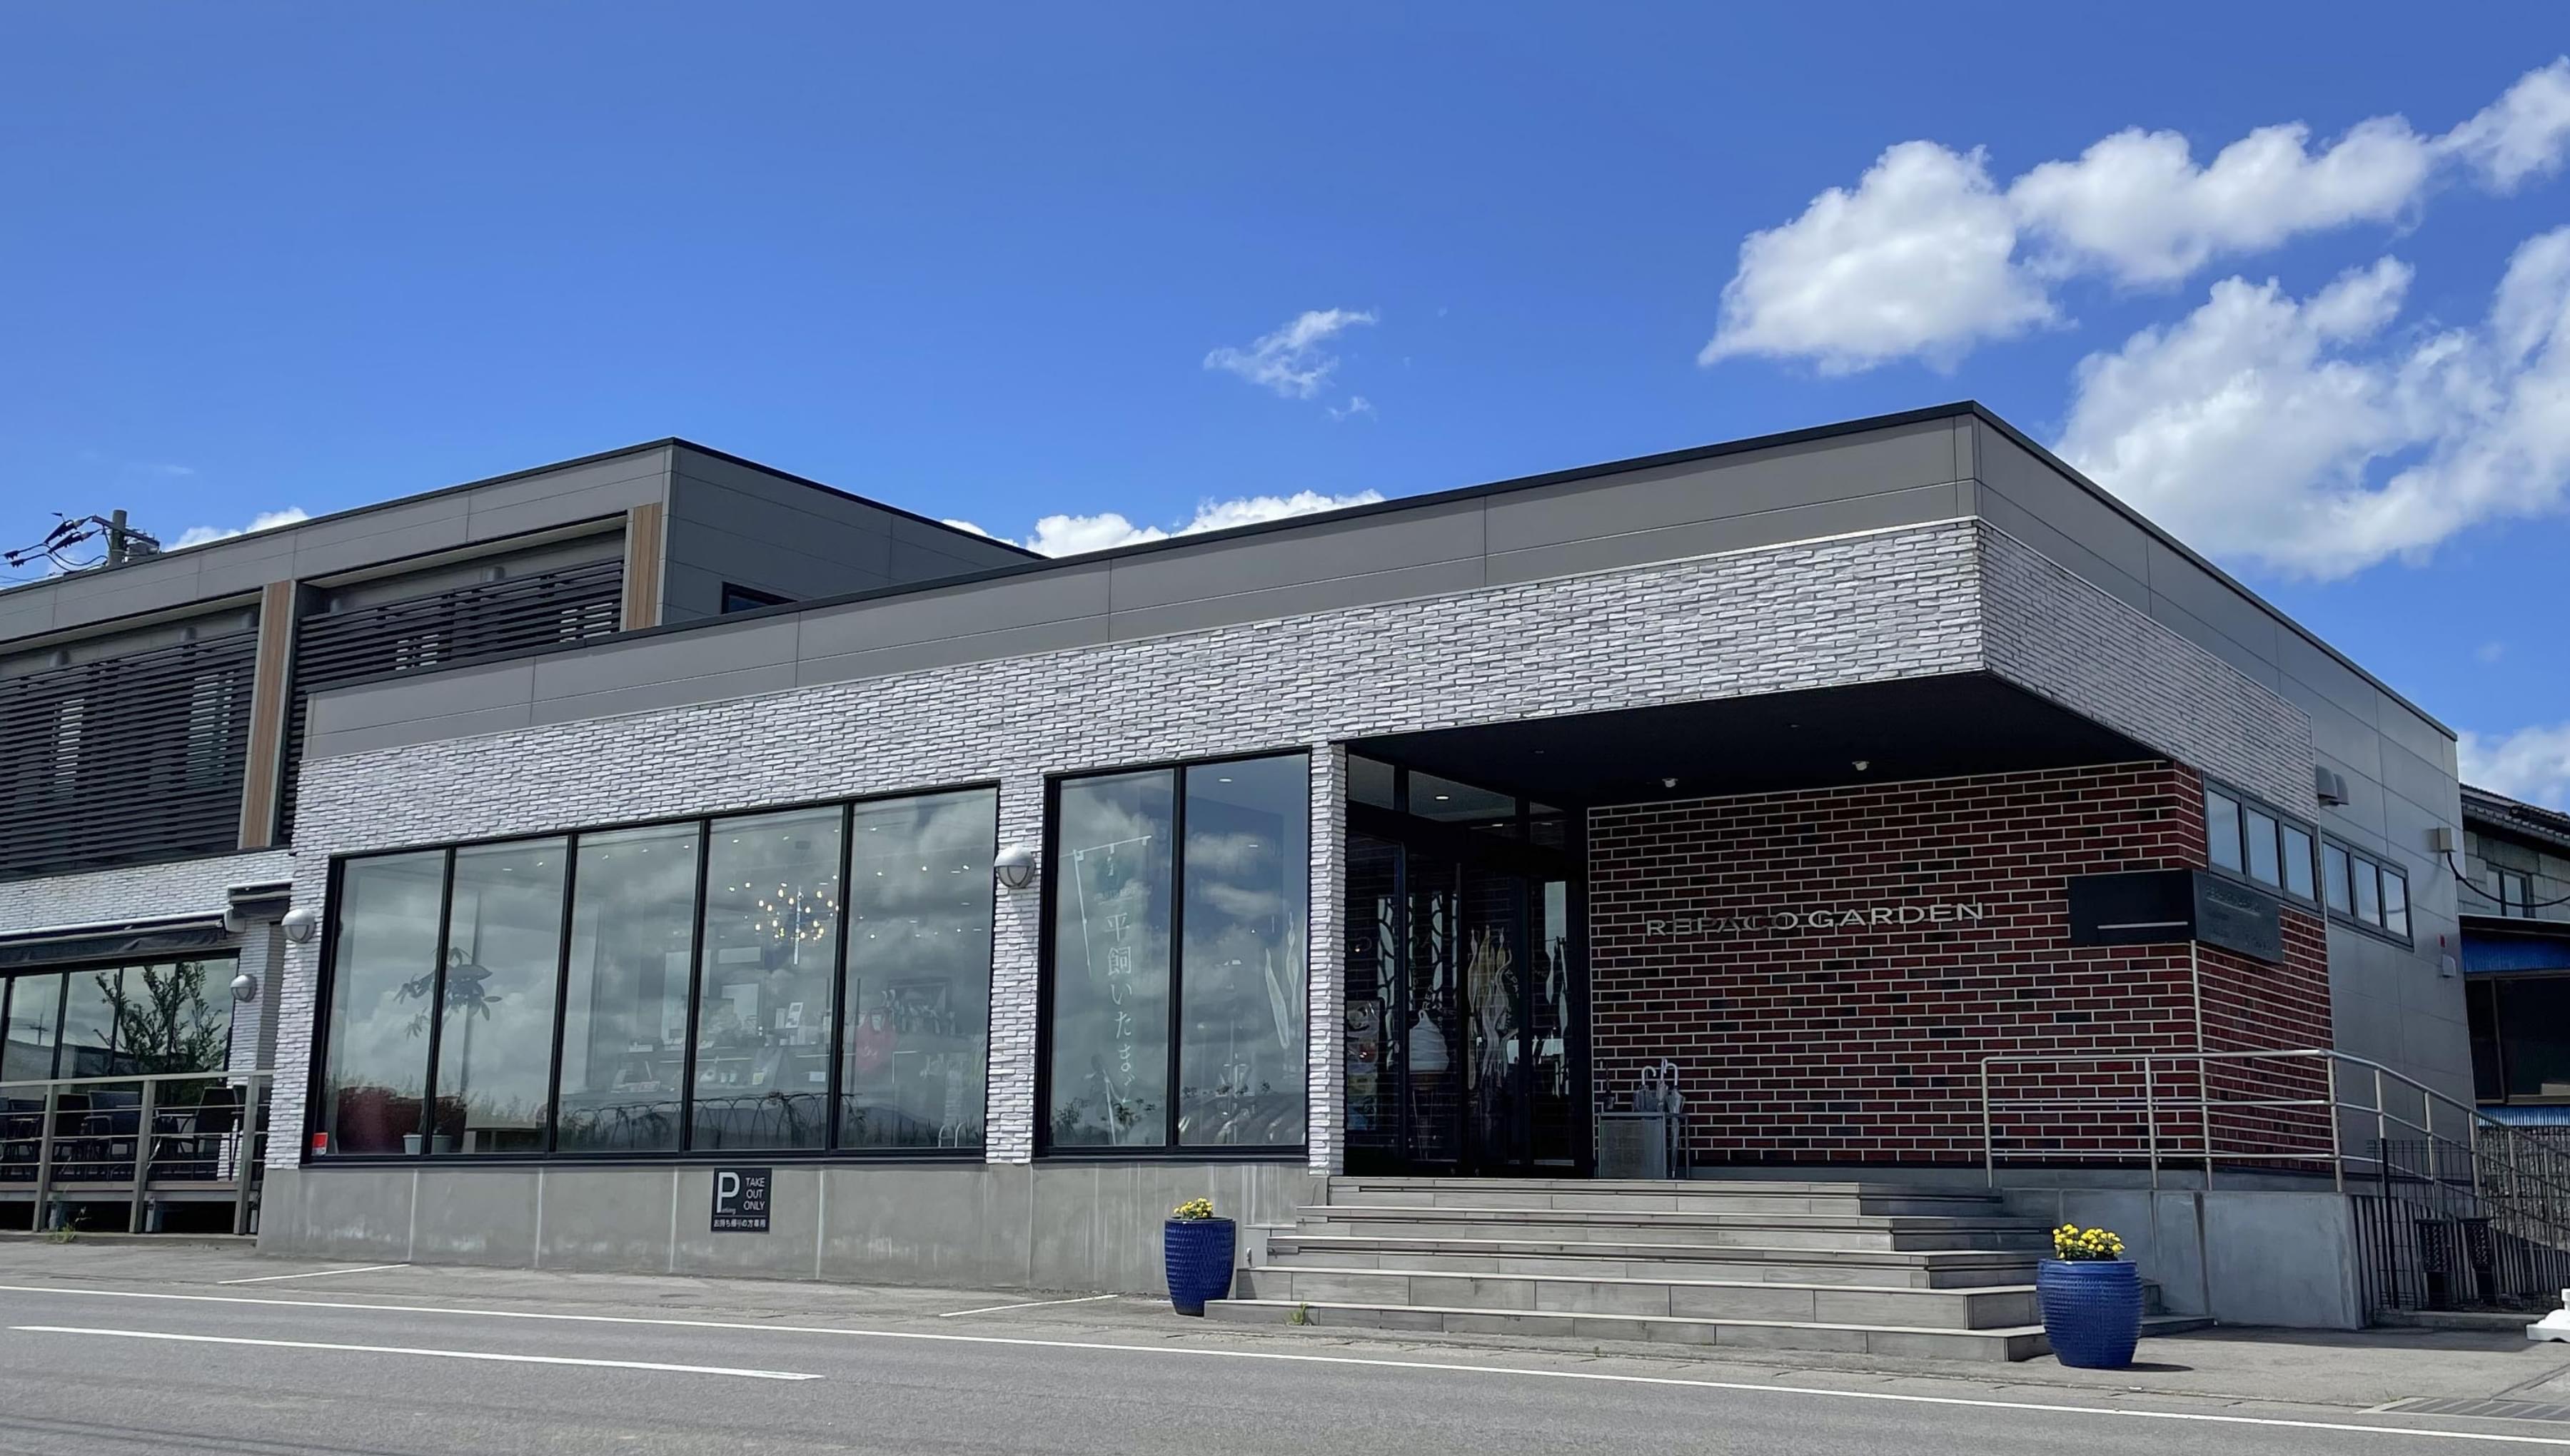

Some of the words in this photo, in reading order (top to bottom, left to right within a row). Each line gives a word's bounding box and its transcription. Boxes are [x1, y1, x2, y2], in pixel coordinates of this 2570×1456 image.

[1646, 911, 1799, 937] REPACO
[1808, 902, 1983, 929] GARDEN
[745, 1177, 765, 1188] TAKE
[746, 1188, 764, 1199] OUT
[743, 1200, 765, 1210] ONLY
